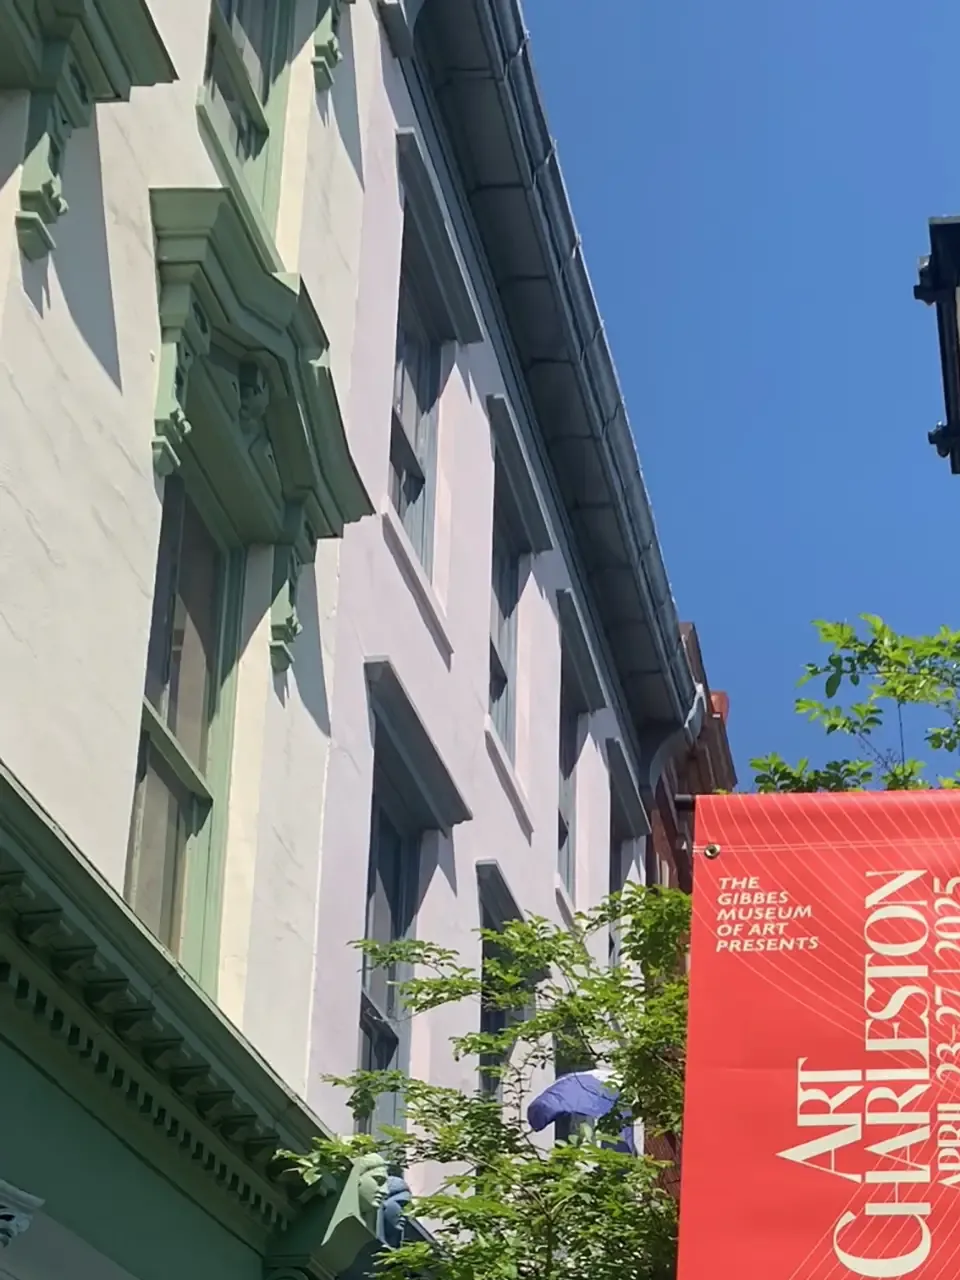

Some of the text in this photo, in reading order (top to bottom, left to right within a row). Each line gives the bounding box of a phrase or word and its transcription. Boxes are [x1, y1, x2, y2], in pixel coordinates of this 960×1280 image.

[719, 876, 759, 890] THE
[717, 891, 789, 906] GIBBES
[716, 905, 812, 921] MUSEUM
[717, 922, 789, 937] OF ART
[716, 936, 819, 952] PRESENTS
[833, 869, 932, 1279] CHARLESTON
[775, 1056, 864, 1184] ART
